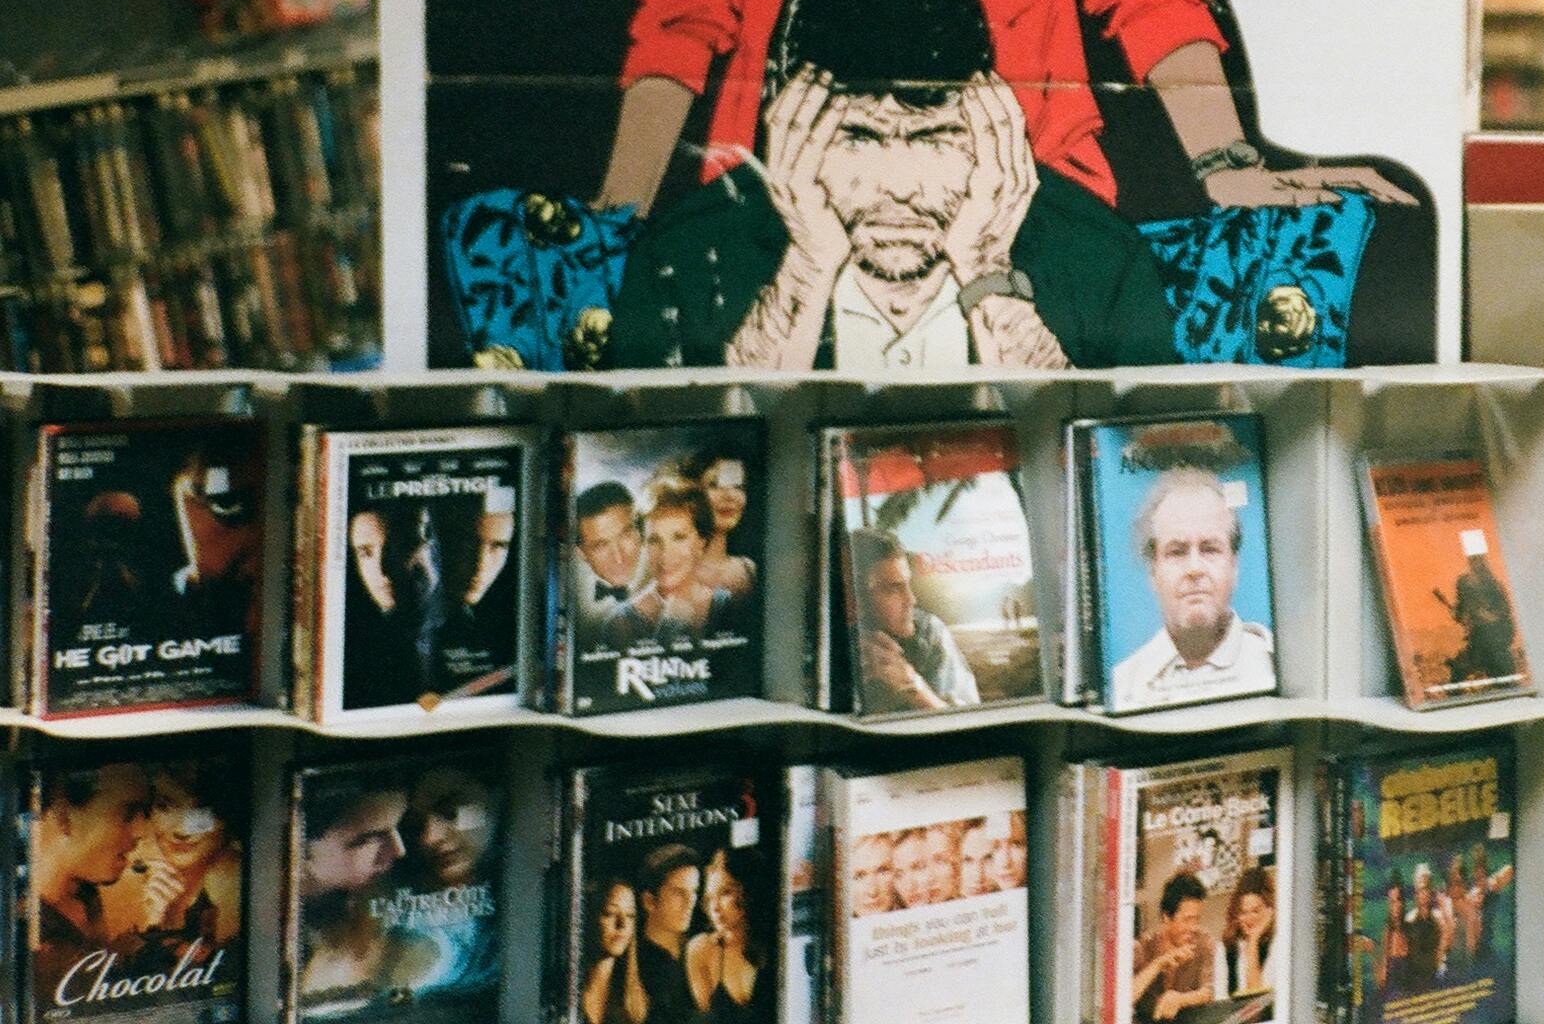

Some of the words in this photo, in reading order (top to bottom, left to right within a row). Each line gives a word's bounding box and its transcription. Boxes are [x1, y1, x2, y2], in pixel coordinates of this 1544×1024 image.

[55, 648, 91, 669] HE
[96, 643, 153, 670] GOT
[157, 634, 242, 660] GAME
[605, 807, 740, 842] INTENTIONS
[1143, 810, 1168, 830] Le
[55, 937, 225, 1007] Chocolat
